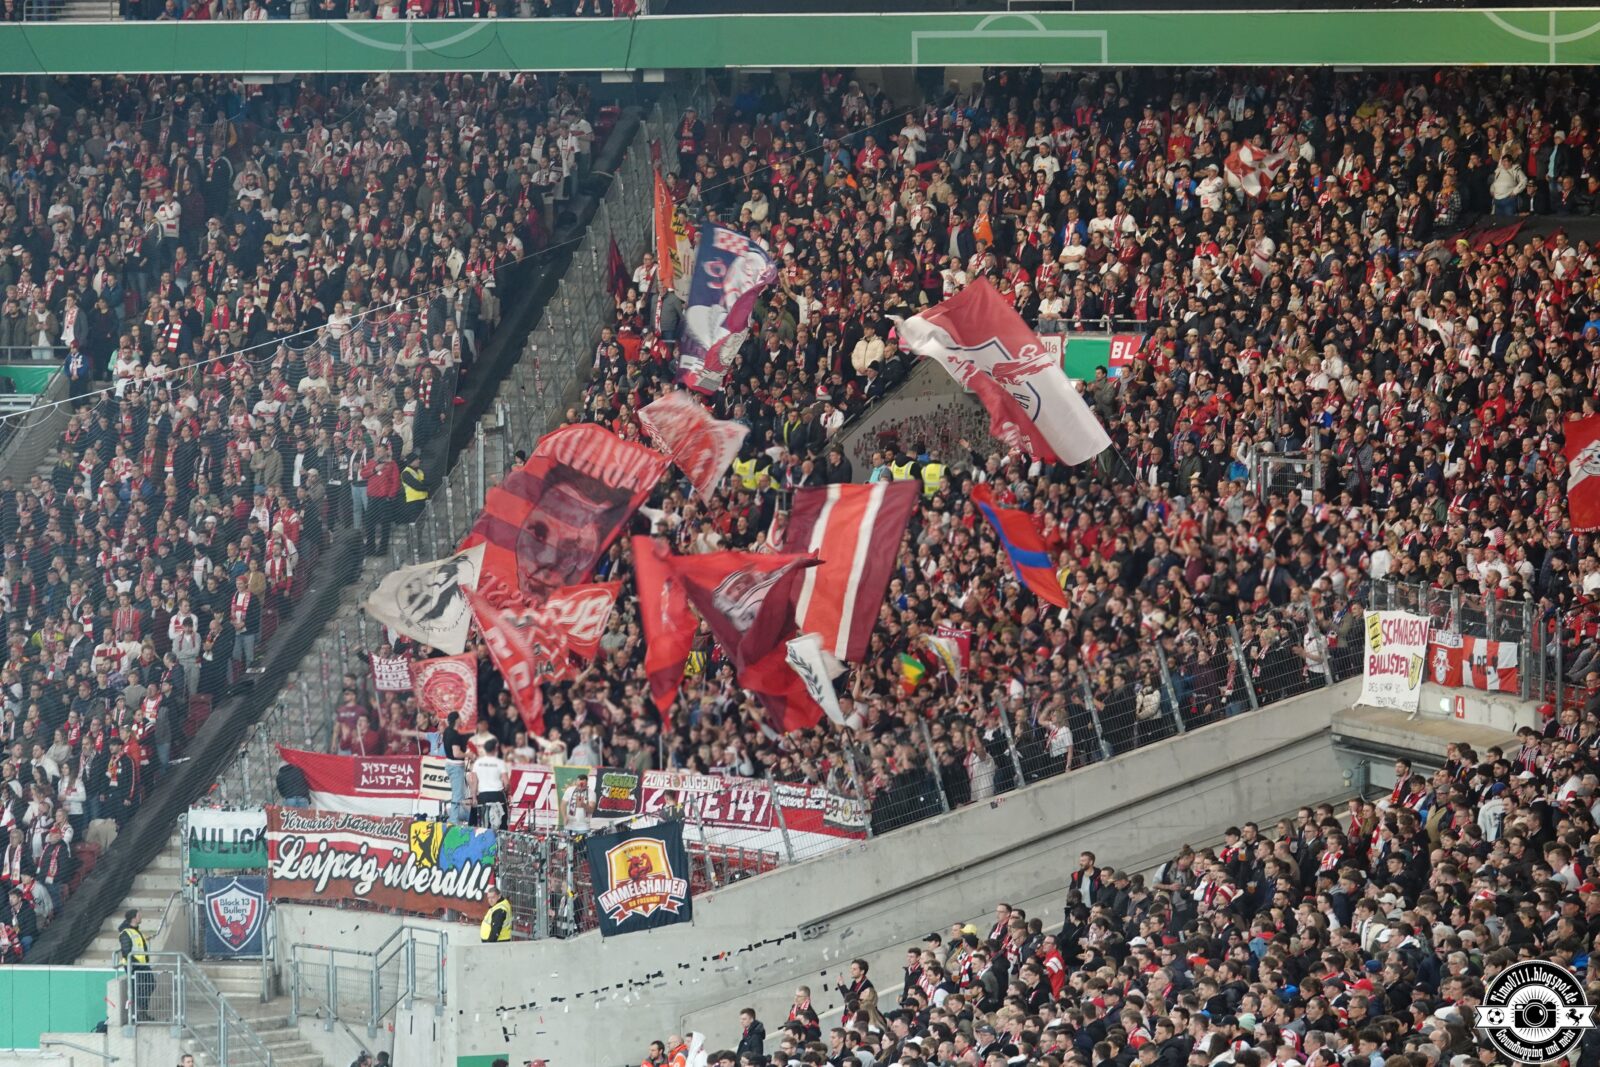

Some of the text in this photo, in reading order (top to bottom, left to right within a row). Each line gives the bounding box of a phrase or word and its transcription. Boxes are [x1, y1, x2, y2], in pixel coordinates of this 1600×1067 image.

[1382, 619, 1428, 646] SCHWABEN
[1369, 653, 1410, 678] BALLISTEN
[1457, 697, 1463, 717] 4
[361, 762, 415, 774] SYSTEMA
[361, 775, 414, 787] ALISTRA
[643, 773, 671, 788] ZONE
[683, 774, 720, 791] JUGEND
[645, 788, 720, 820] ZNE
[726, 788, 771, 823] 147
[188, 825, 268, 855] AULIGK
[273, 835, 493, 901] Leipzig überall!
[219, 898, 250, 906] Block 13
[601, 879, 685, 911] AMMELSHAINER
[223, 906, 247, 915] Bullen
